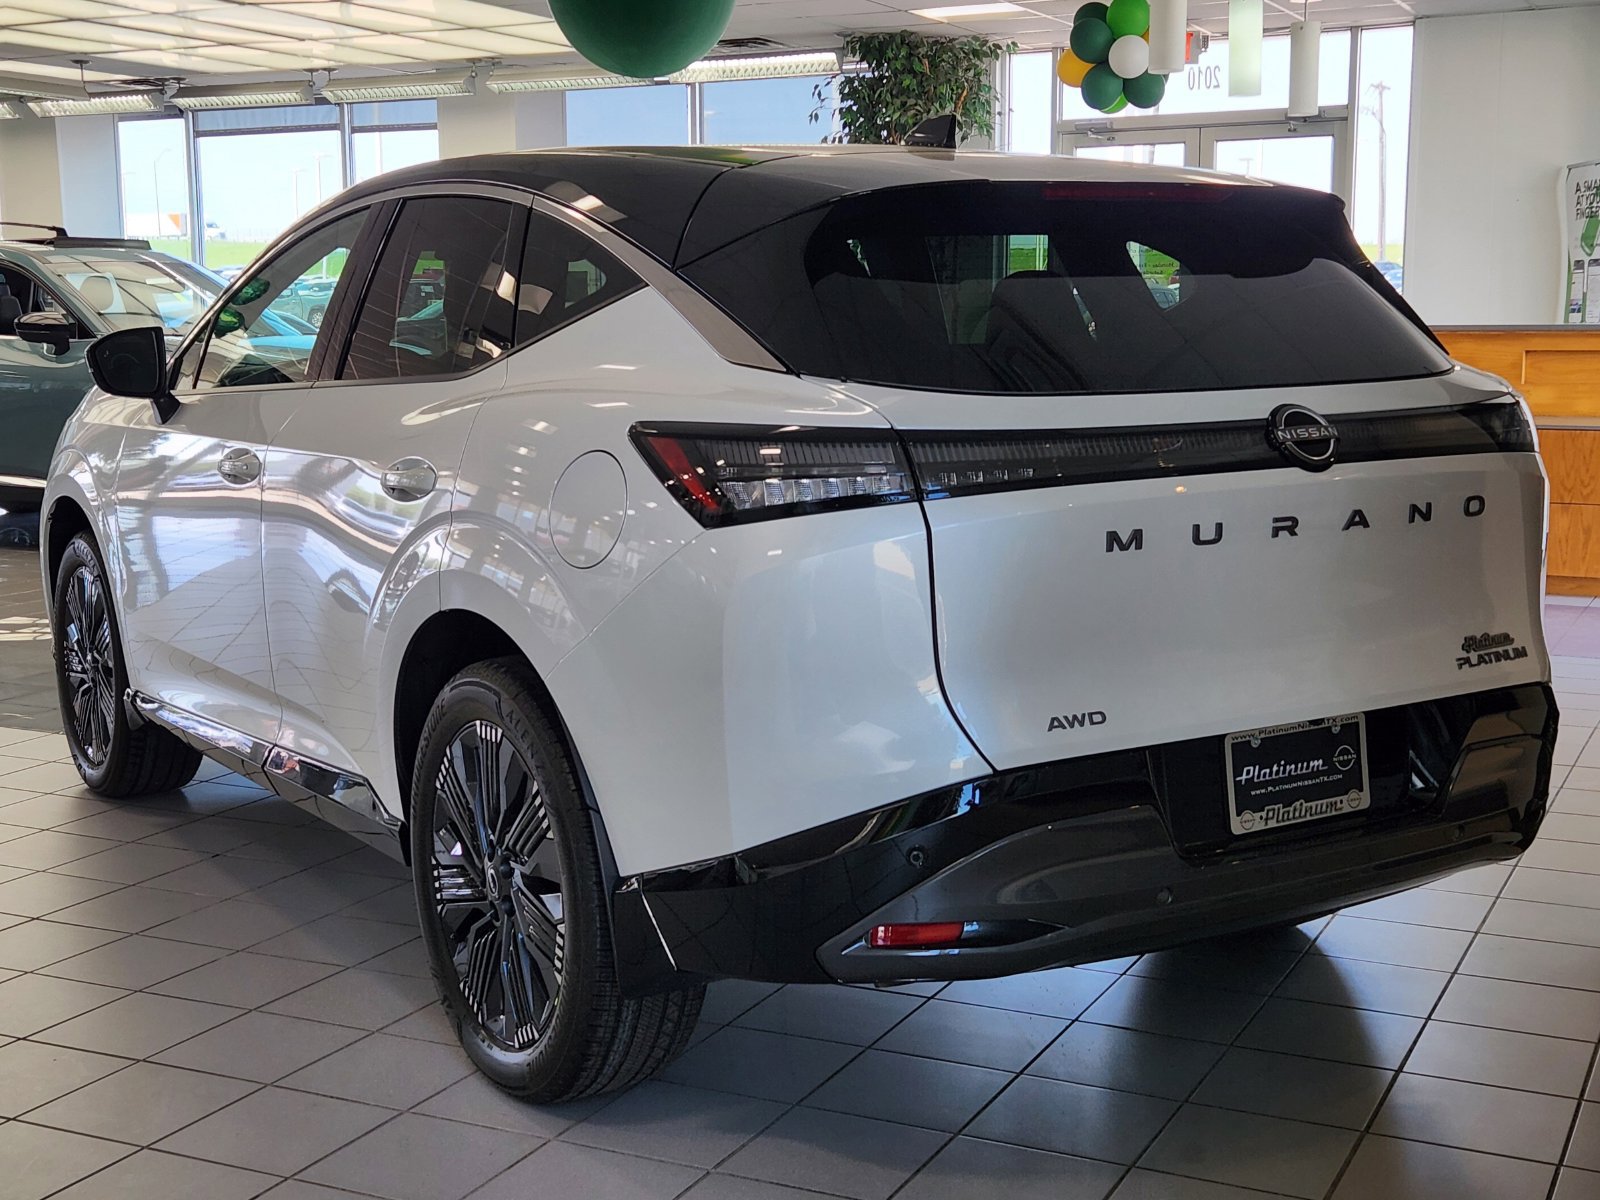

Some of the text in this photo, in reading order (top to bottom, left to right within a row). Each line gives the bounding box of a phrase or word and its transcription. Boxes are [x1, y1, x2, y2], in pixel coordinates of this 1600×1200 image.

[1575, 179, 1600, 195] A SMA
[1575, 193, 1585, 208] AT
[1277, 426, 1338, 440] NISSAN
[1105, 495, 1486, 553] MURANO
[1455, 646, 1528, 670] PLATINUM
[1047, 710, 1108, 732] AWD
[1333, 753, 1357, 762] NISSAN
[1235, 758, 1329, 785] Platinum
[1263, 800, 1344, 827] Platinum
